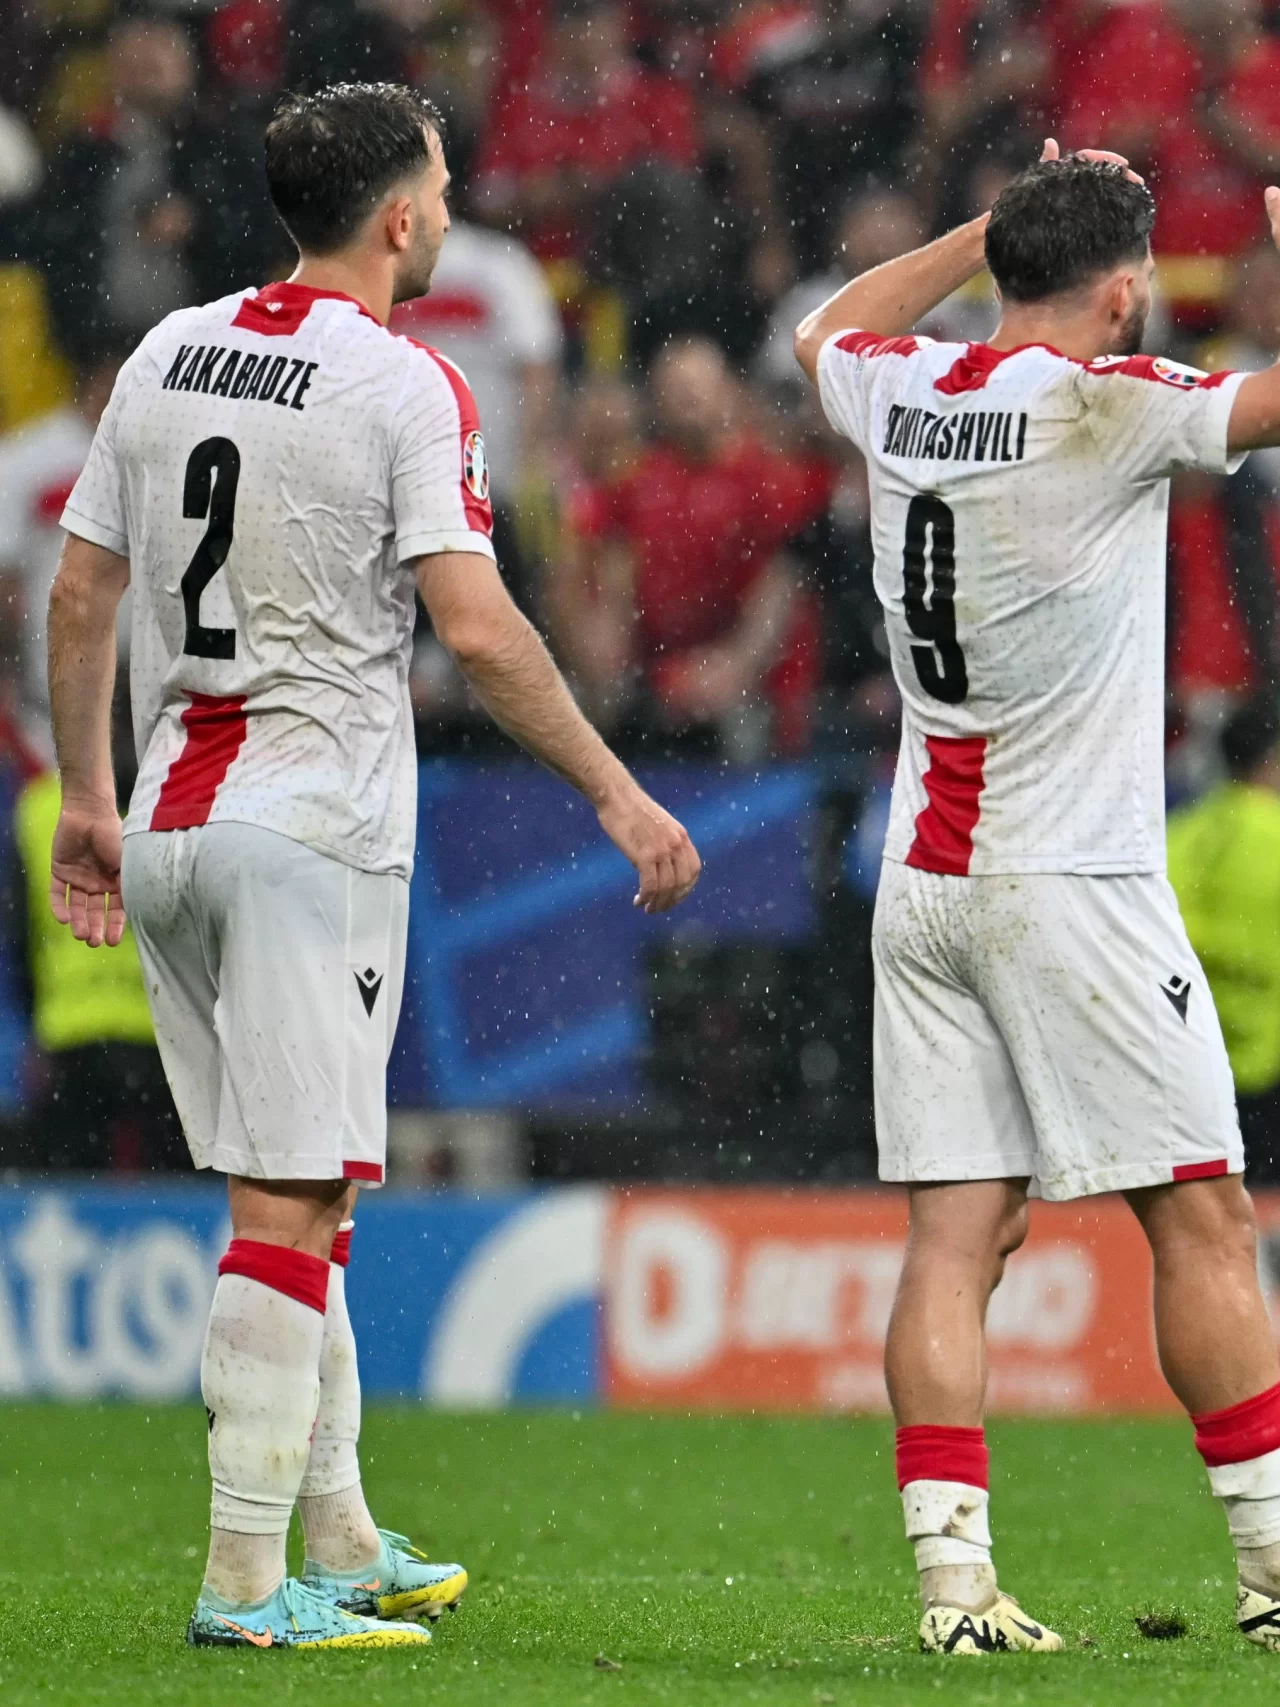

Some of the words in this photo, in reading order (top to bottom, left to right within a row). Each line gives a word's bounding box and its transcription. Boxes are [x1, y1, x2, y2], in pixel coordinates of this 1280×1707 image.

[162, 344, 319, 410] KAKABADZE
[883, 403, 1027, 461] DAVITASHVILI
[181, 436, 241, 660] 2
[902, 495, 969, 704] 9
